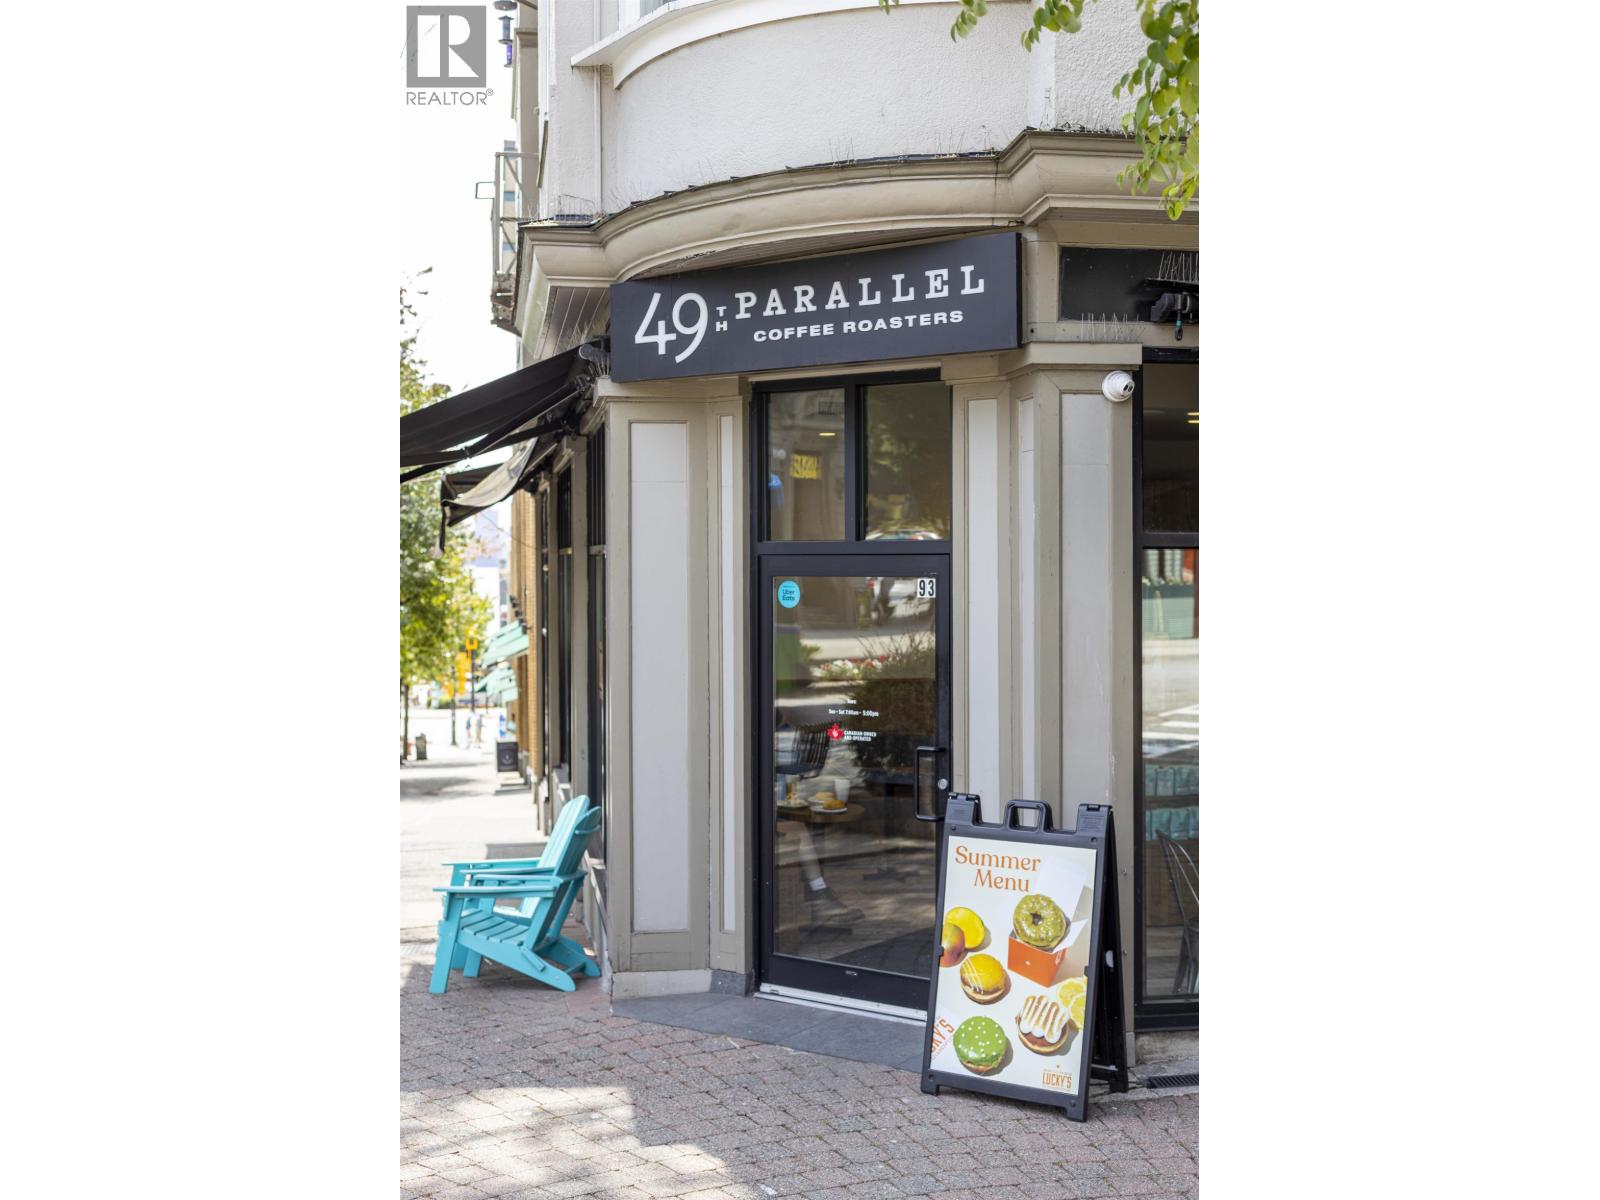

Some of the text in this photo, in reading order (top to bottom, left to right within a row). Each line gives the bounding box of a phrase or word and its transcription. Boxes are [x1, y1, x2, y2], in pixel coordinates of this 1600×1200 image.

[635, 292, 708, 363] 49
[735, 264, 985, 320] PARALLEL
[753, 310, 964, 343] COFFEE ROASTERS
[919, 579, 935, 597] 93
[954, 845, 1041, 872] Summer
[974, 868, 1030, 892] Menu
[1042, 1071, 1072, 1089] LUCKY'S
